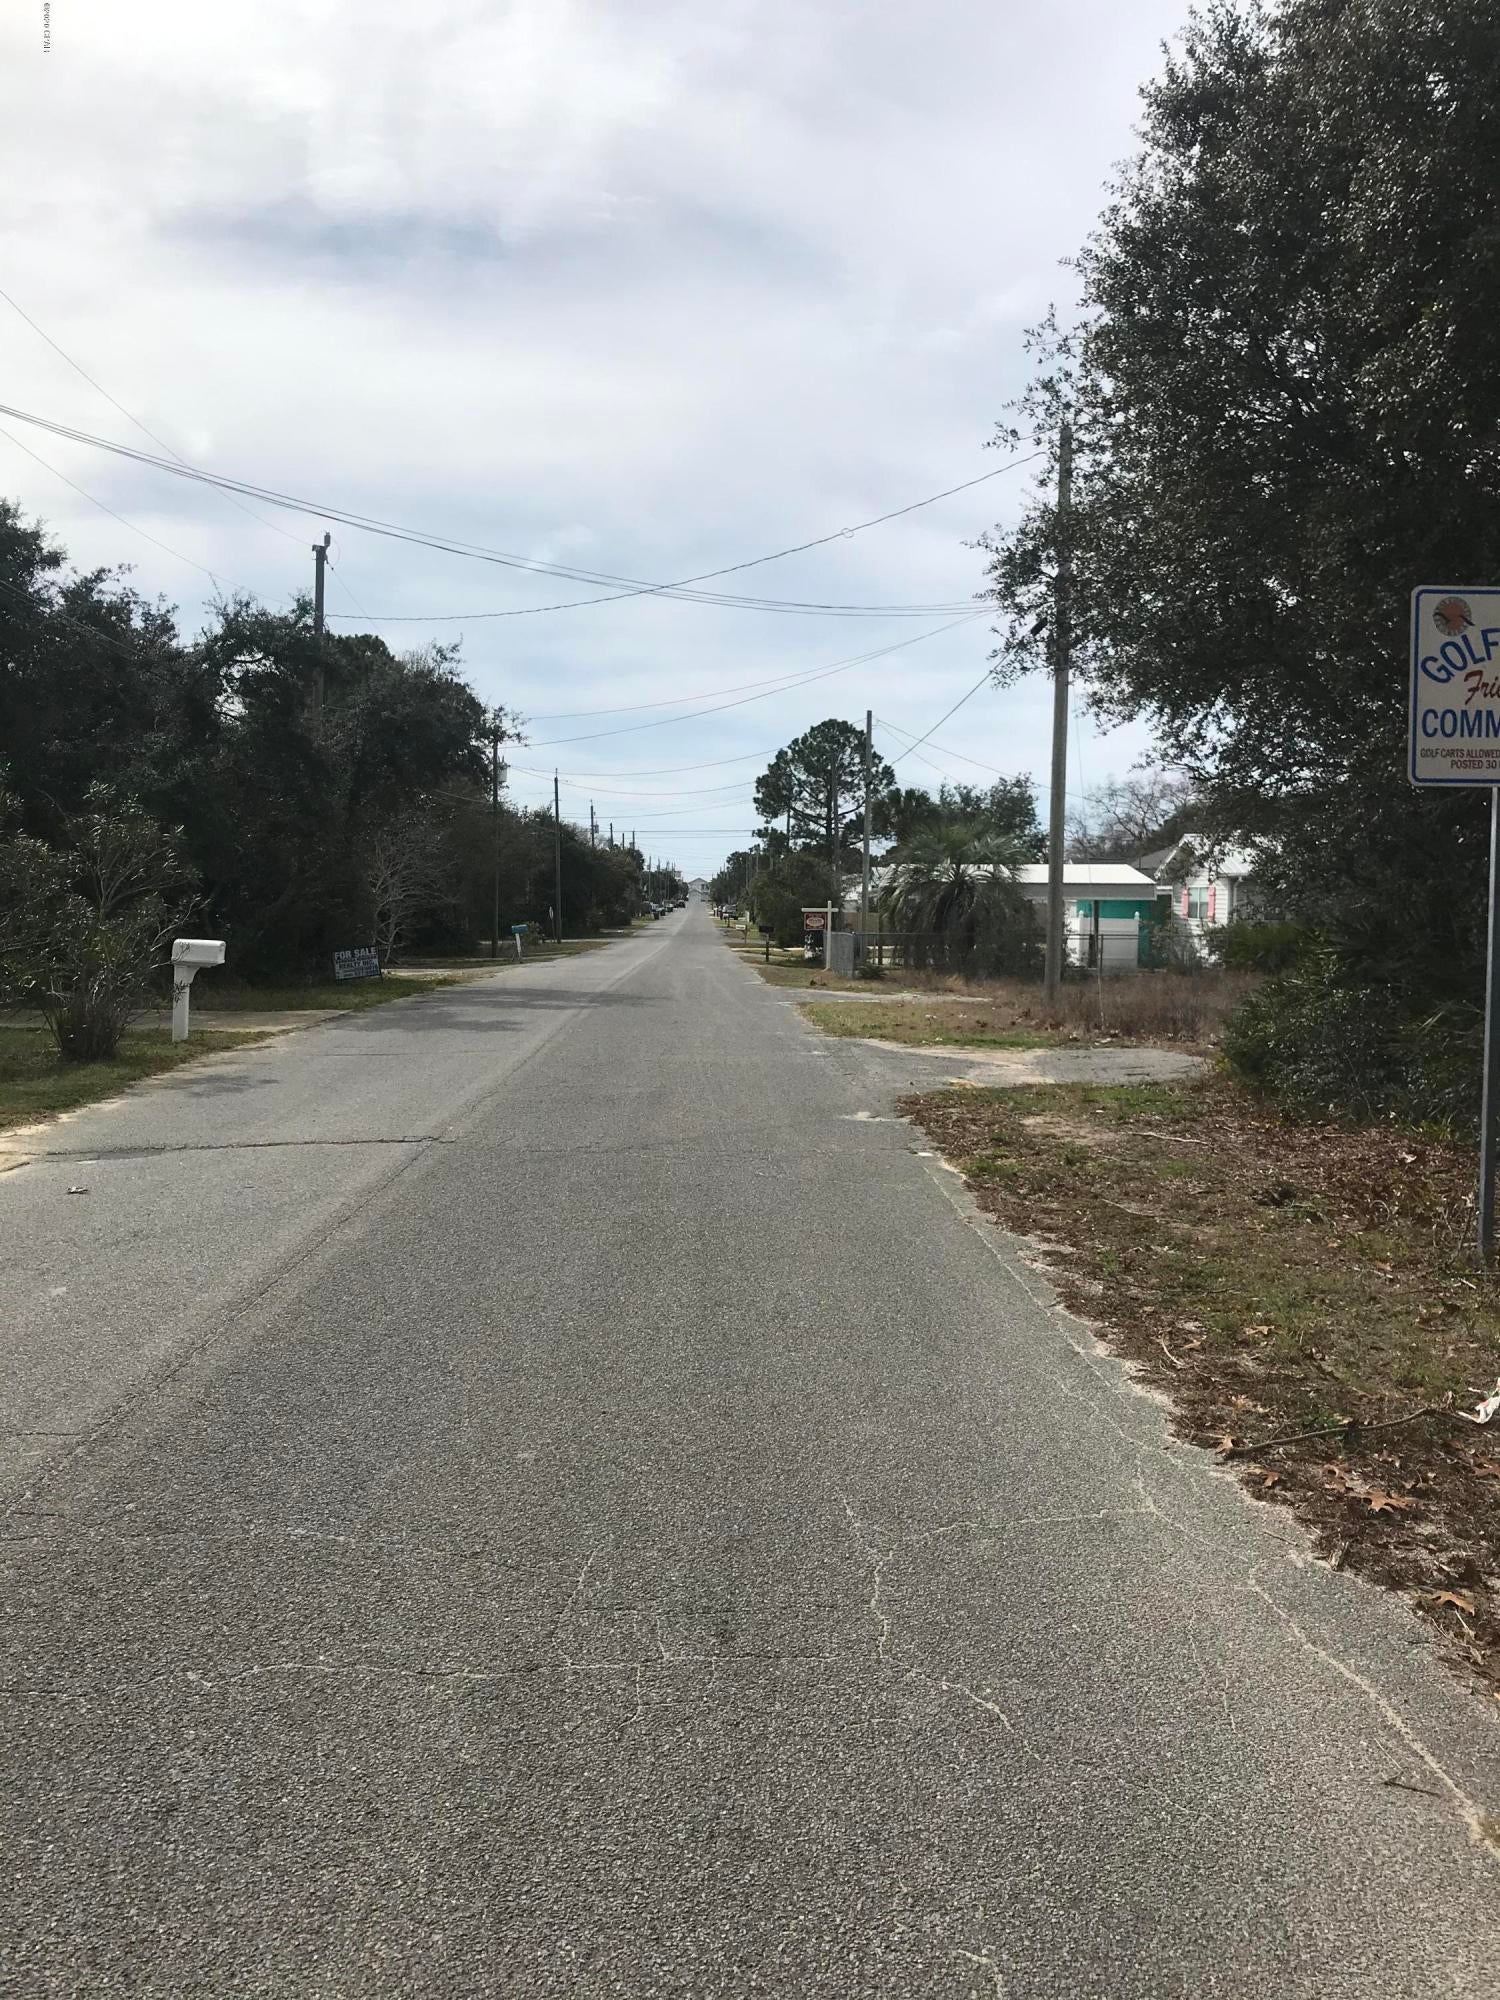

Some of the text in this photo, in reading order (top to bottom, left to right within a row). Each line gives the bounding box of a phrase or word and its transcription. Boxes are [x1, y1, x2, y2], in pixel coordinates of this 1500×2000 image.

[1420, 627, 1500, 684] GOLF
[1420, 748, 1440, 758] GOLF
[1441, 748, 1465, 758] CARTS
[1450, 760, 1483, 769] POSTED
[1485, 760, 1497, 769] 30
[334, 951, 351, 960] FOR
[353, 947, 376, 957] SALE
